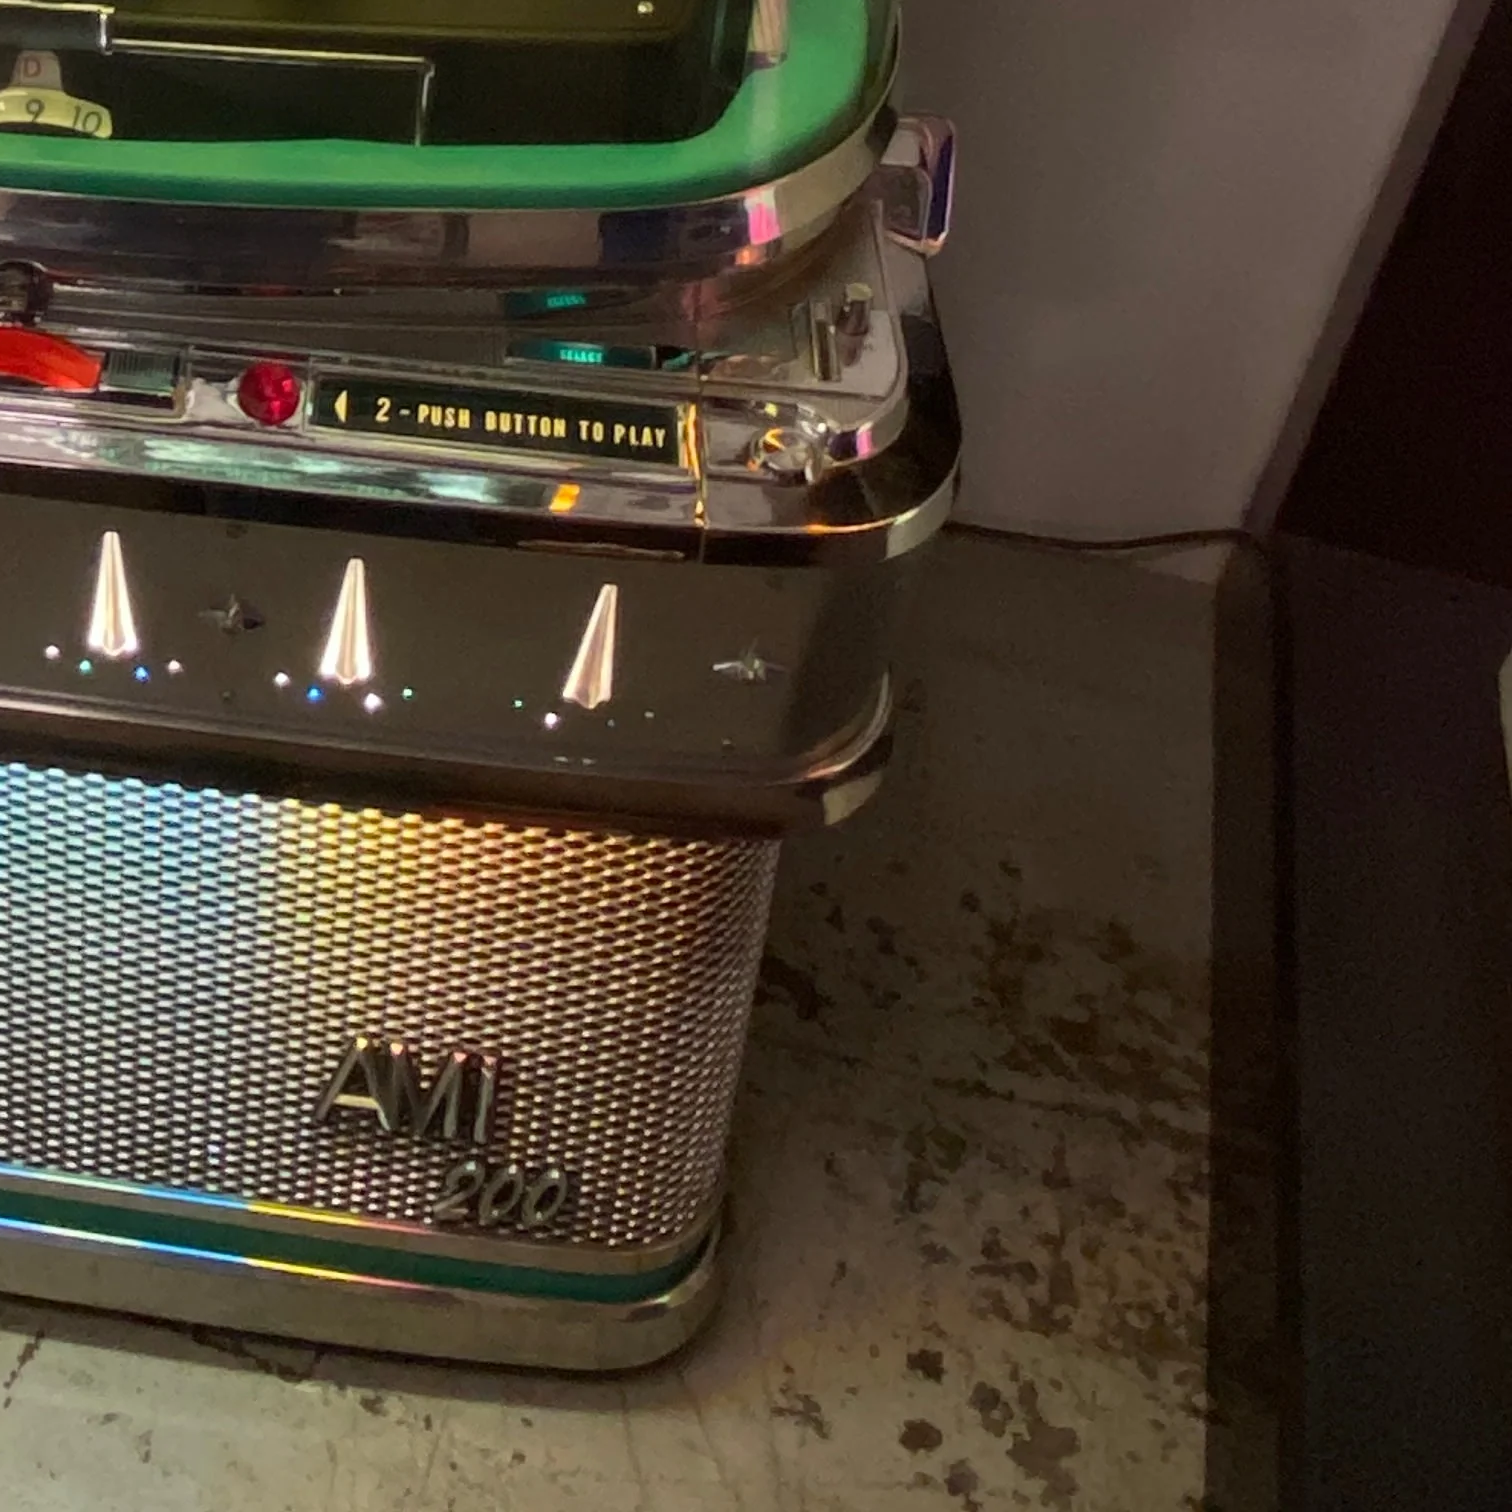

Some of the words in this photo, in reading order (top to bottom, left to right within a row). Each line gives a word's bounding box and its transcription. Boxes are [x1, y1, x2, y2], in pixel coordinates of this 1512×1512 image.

[26, 98, 45, 123] 9
[71, 104, 103, 134] 10
[374, 396, 392, 423] 2
[417, 403, 472, 429] PUSH
[484, 410, 567, 439] BUTTON
[579, 419, 604, 444] TO
[612, 423, 667, 449] PLAY
[314, 1037, 502, 1145] AMI
[433, 1158, 568, 1228] 200
